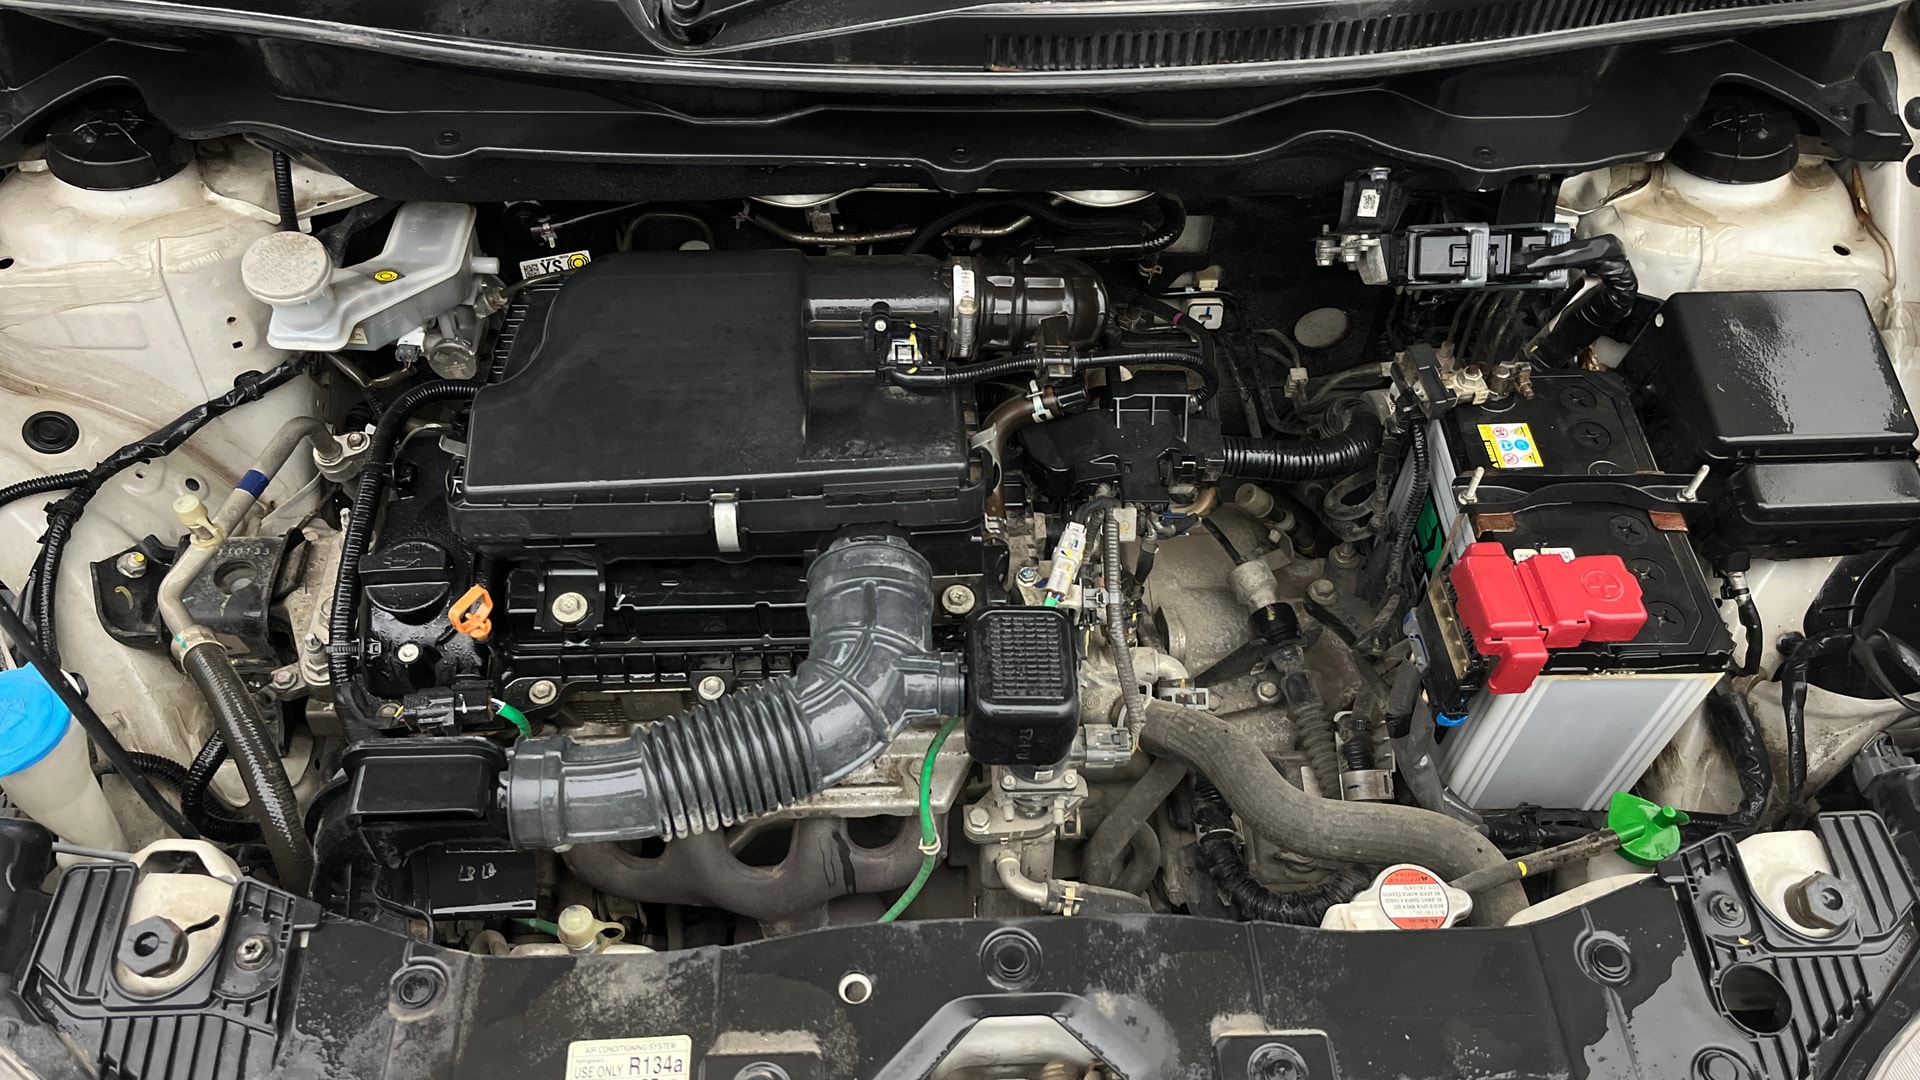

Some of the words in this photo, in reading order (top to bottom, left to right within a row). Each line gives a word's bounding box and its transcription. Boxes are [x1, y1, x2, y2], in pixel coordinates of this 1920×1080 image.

[541, 260, 563, 273] YS
[585, 1046, 596, 1054] AIR
[598, 1044, 647, 1053] CONDITIONING
[649, 1042, 676, 1050] SYSTEM
[574, 1066, 595, 1079] USE
[597, 1064, 624, 1077] ONLY
[629, 1055, 683, 1075] R134a
